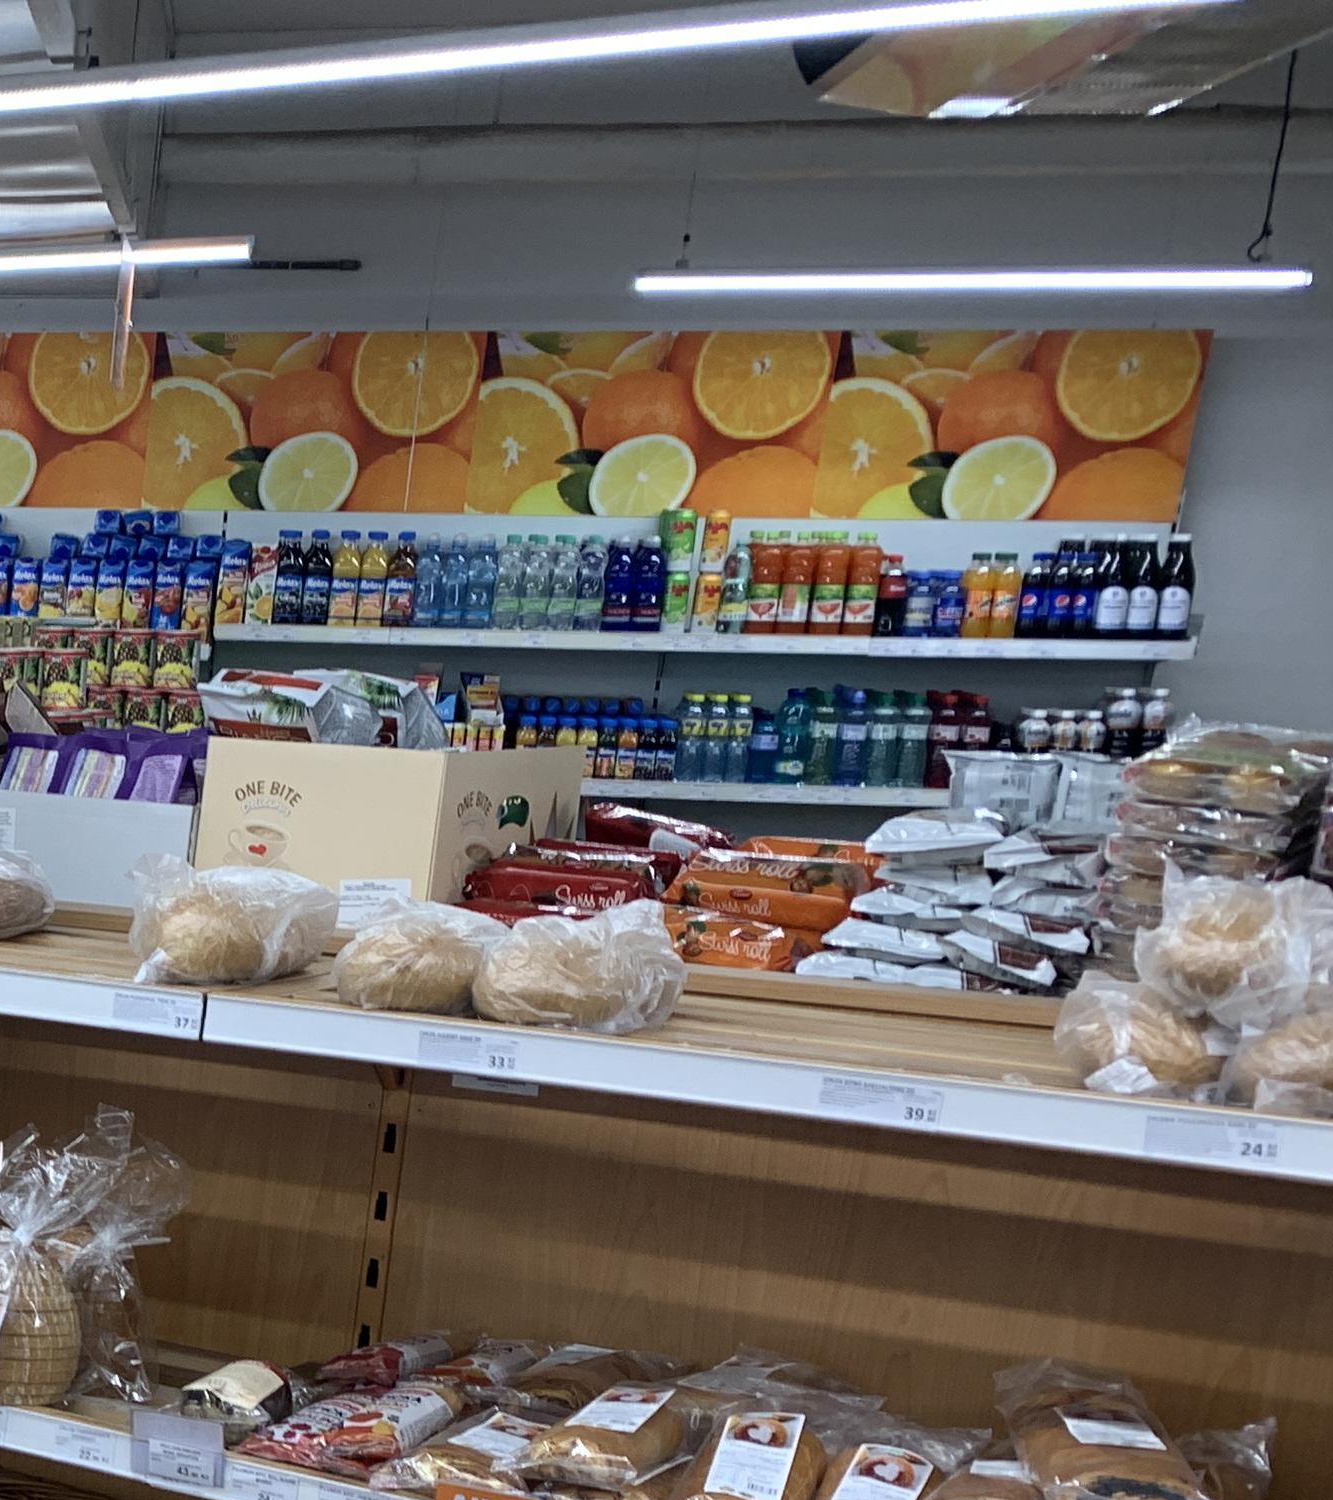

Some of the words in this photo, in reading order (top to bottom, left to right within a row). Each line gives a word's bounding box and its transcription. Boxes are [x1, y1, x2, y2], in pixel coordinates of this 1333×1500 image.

[234, 780, 266, 801] ONE
[270, 781, 303, 807] BITE
[699, 894, 740, 916] Swiss
[743, 897, 772, 918] roll
[700, 932, 740, 957] Swiss
[743, 936, 772, 962] roll
